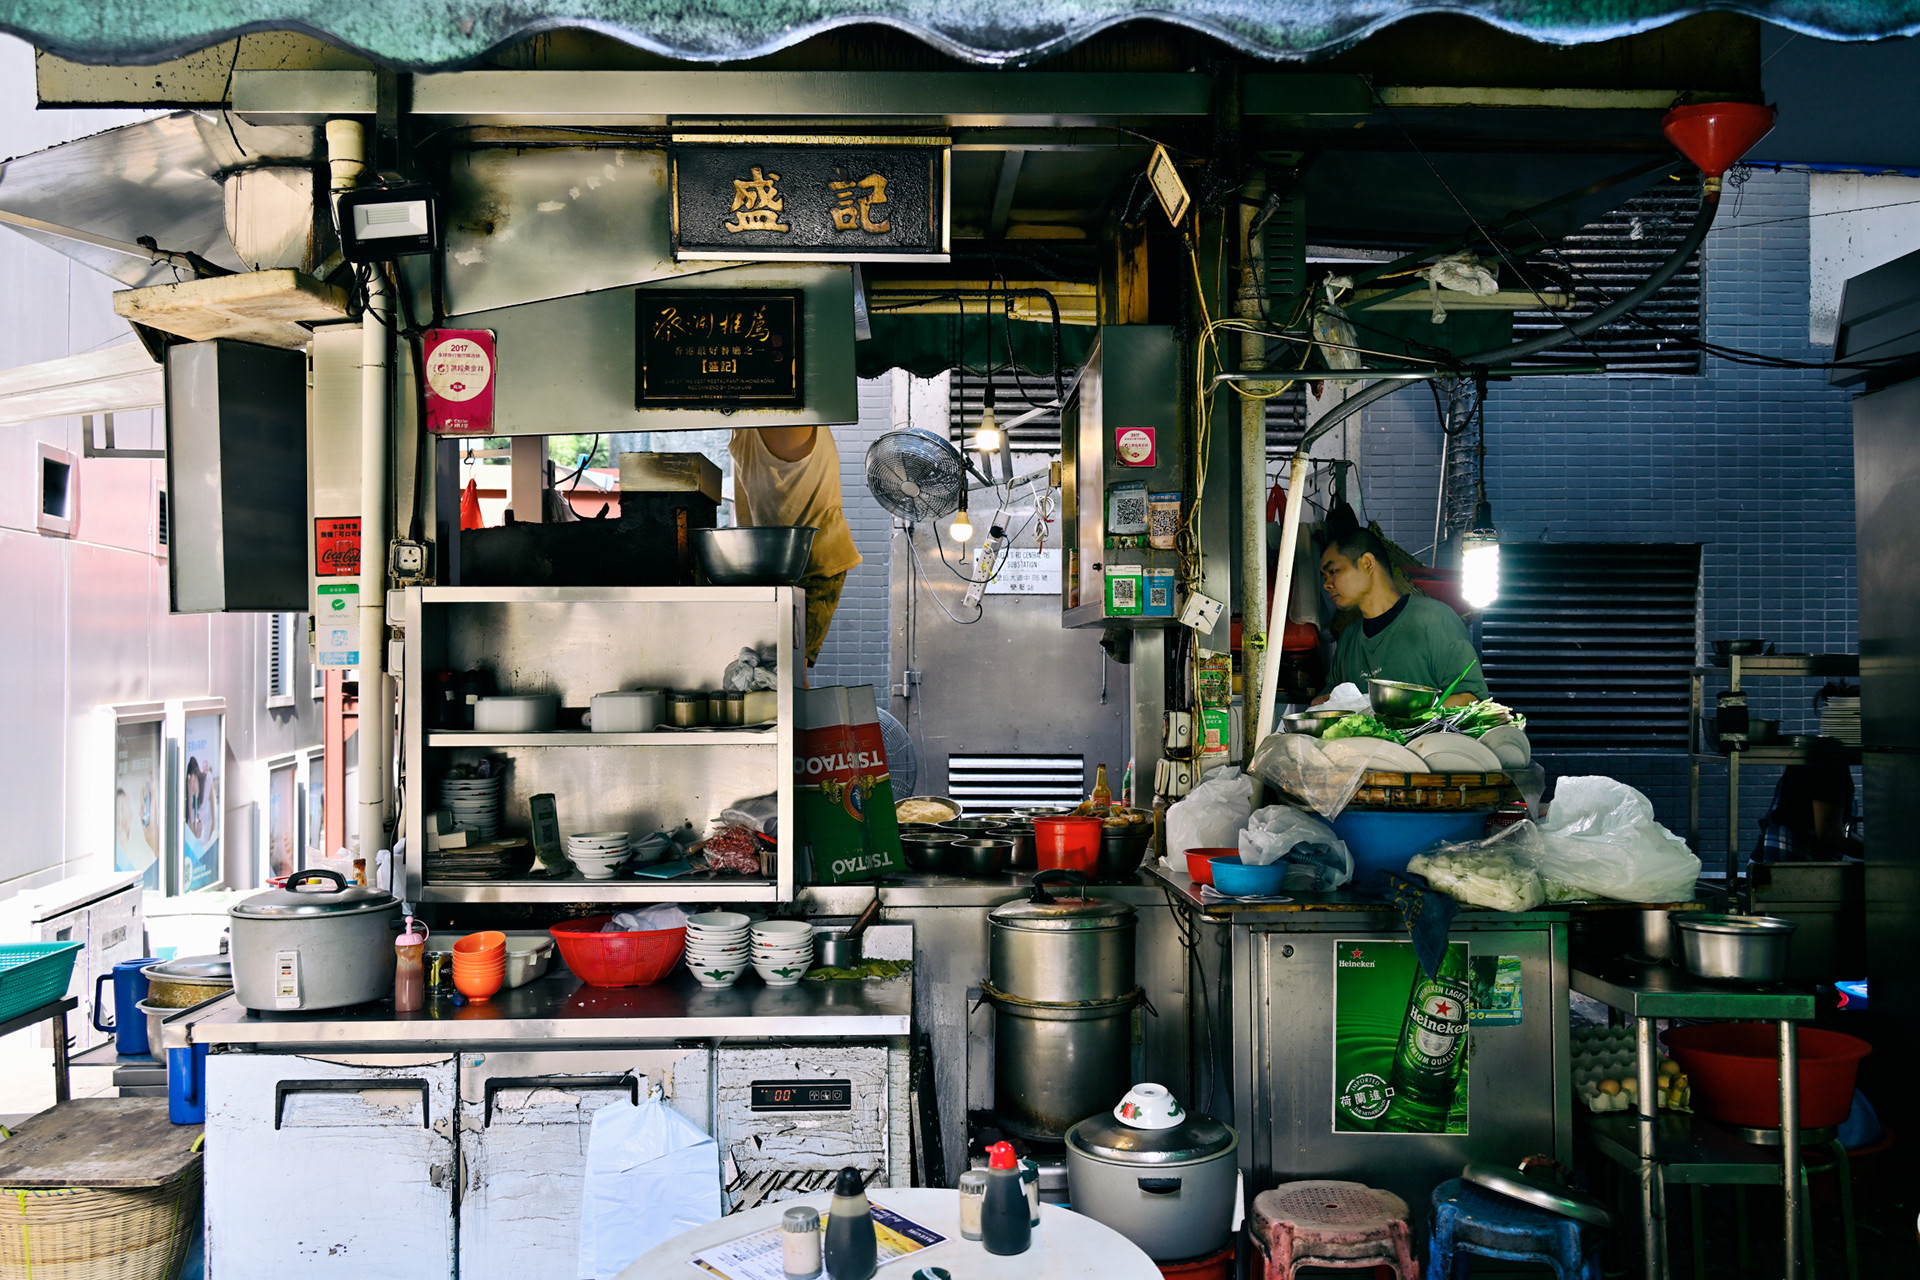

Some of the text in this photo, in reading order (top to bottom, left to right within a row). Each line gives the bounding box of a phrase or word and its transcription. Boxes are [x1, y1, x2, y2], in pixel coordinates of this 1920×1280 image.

[724, 166, 891, 233] 盛記
[451, 344, 469, 352] 2017
[1007, 560, 1038, 568] SUBSTATION
[1339, 960, 1375, 968] Heineken
[1418, 985, 1444, 1001] HEINEKEN
[1444, 987, 1467, 1001] LAGER
[1410, 1005, 1468, 1034] Heineken
[1408, 1033, 1459, 1066] PREMIUM QUALITY
[1351, 1077, 1380, 1091] IMPORTED
[774, 1089, 791, 1101] 00
